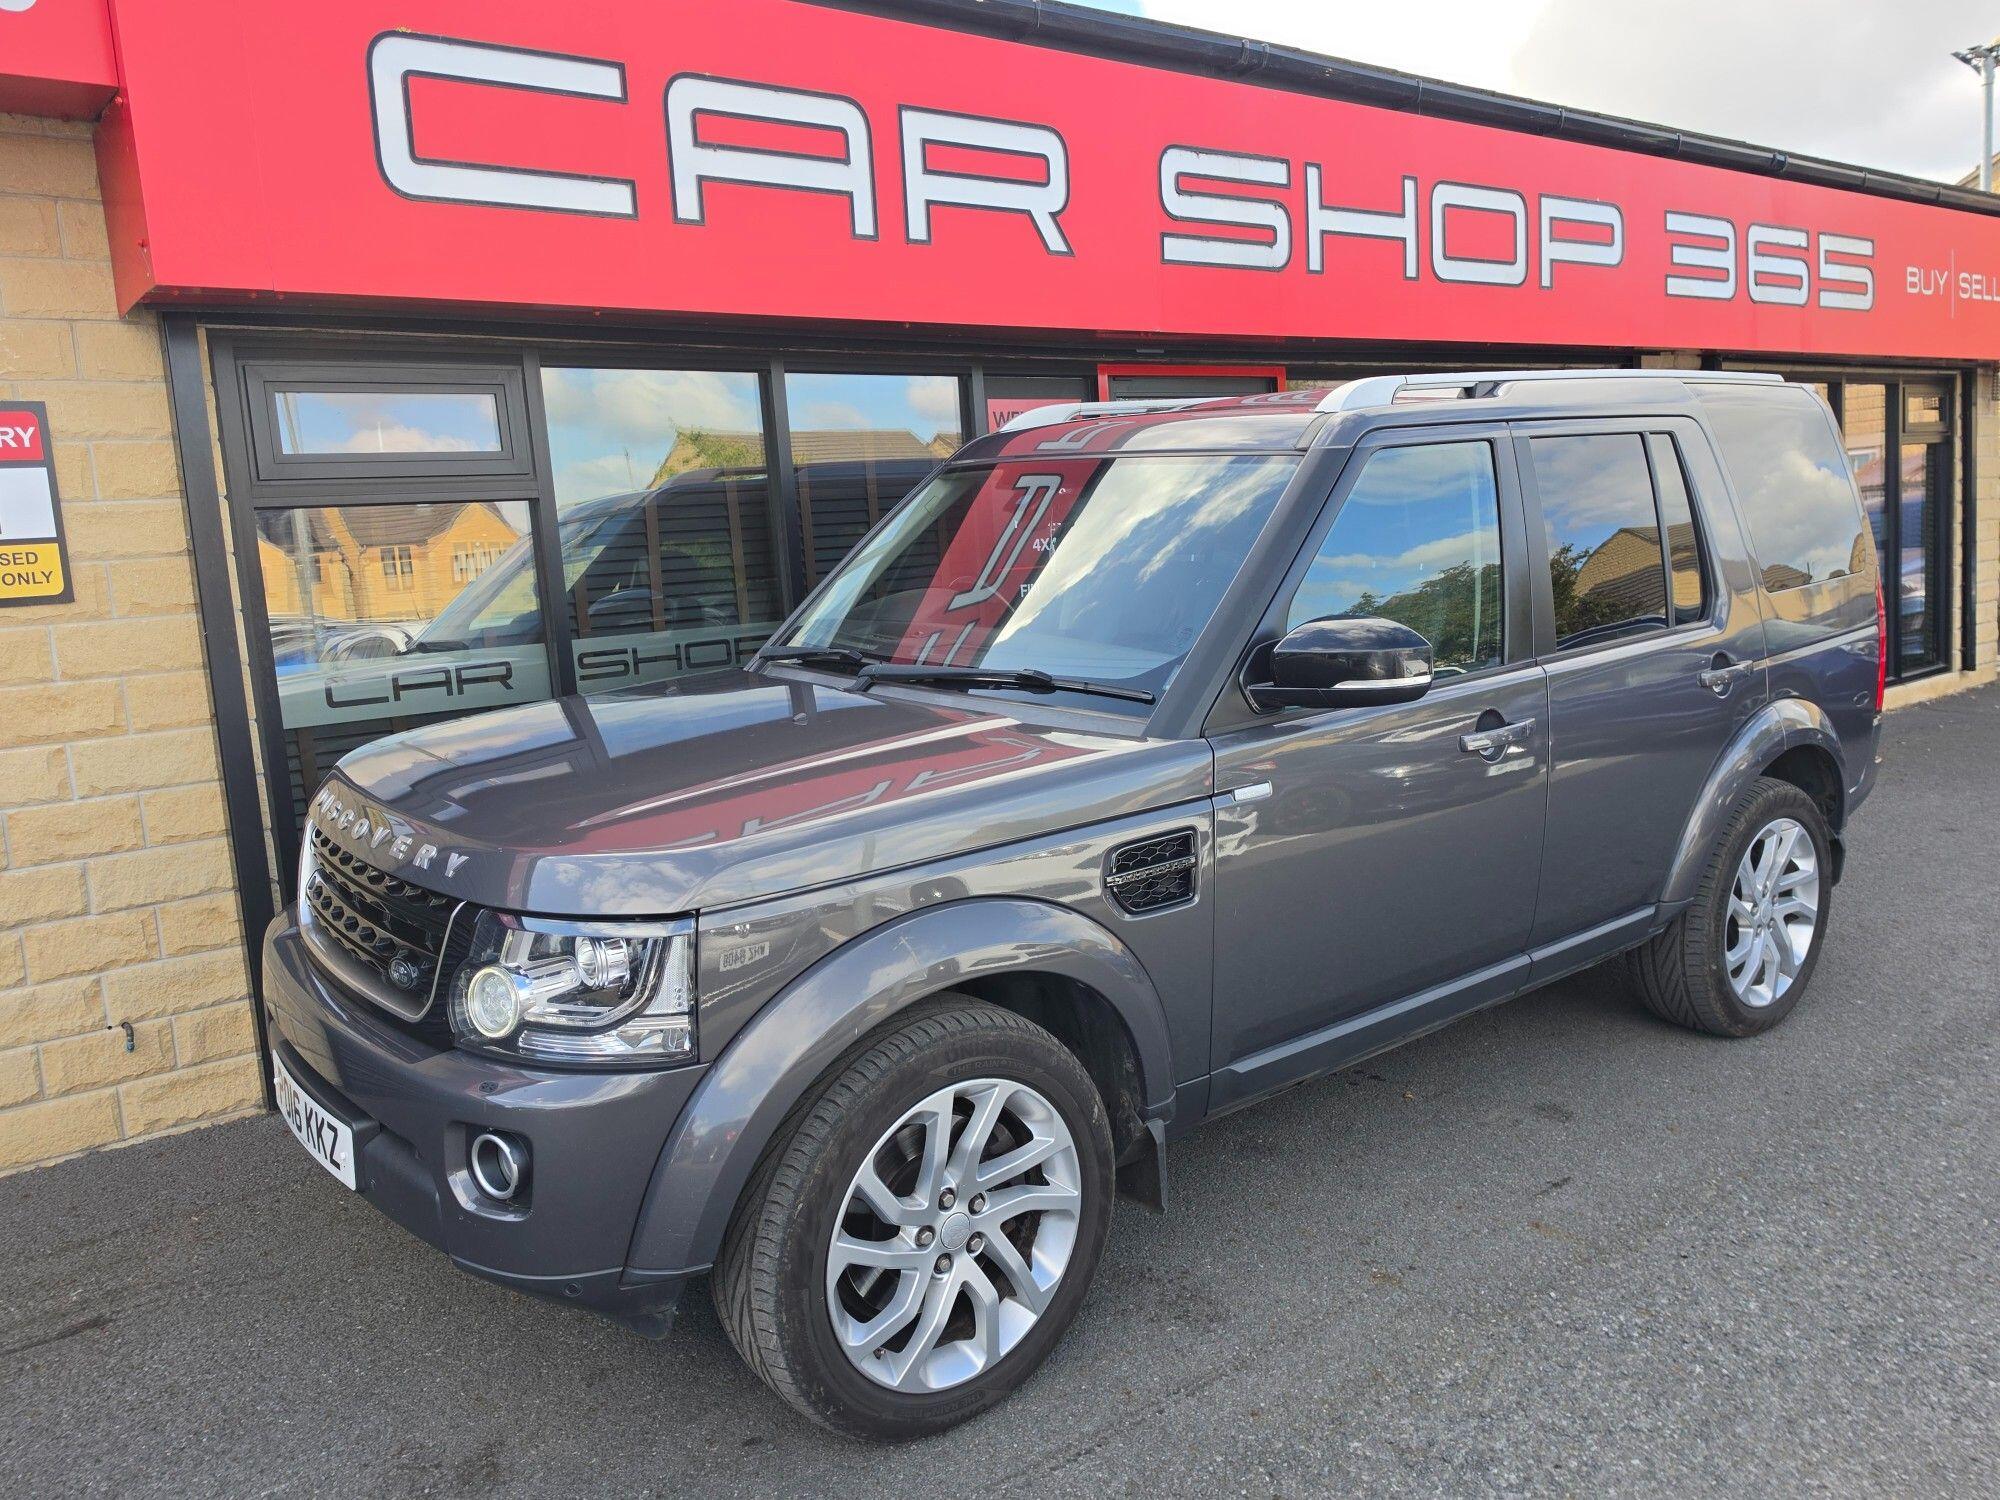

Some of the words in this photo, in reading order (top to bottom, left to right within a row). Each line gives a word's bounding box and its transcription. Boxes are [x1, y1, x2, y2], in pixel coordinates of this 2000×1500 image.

[366, 30, 1075, 257] CAR
[1159, 144, 1625, 290] SHOP
[1665, 209, 1875, 311] 365
[1906, 265, 1948, 296] BUY
[1959, 272, 2000, 302] SELL
[2, 570, 53, 587] ONLY
[324, 660, 514, 709] CAR
[304, 1101, 341, 1171] KKZ
